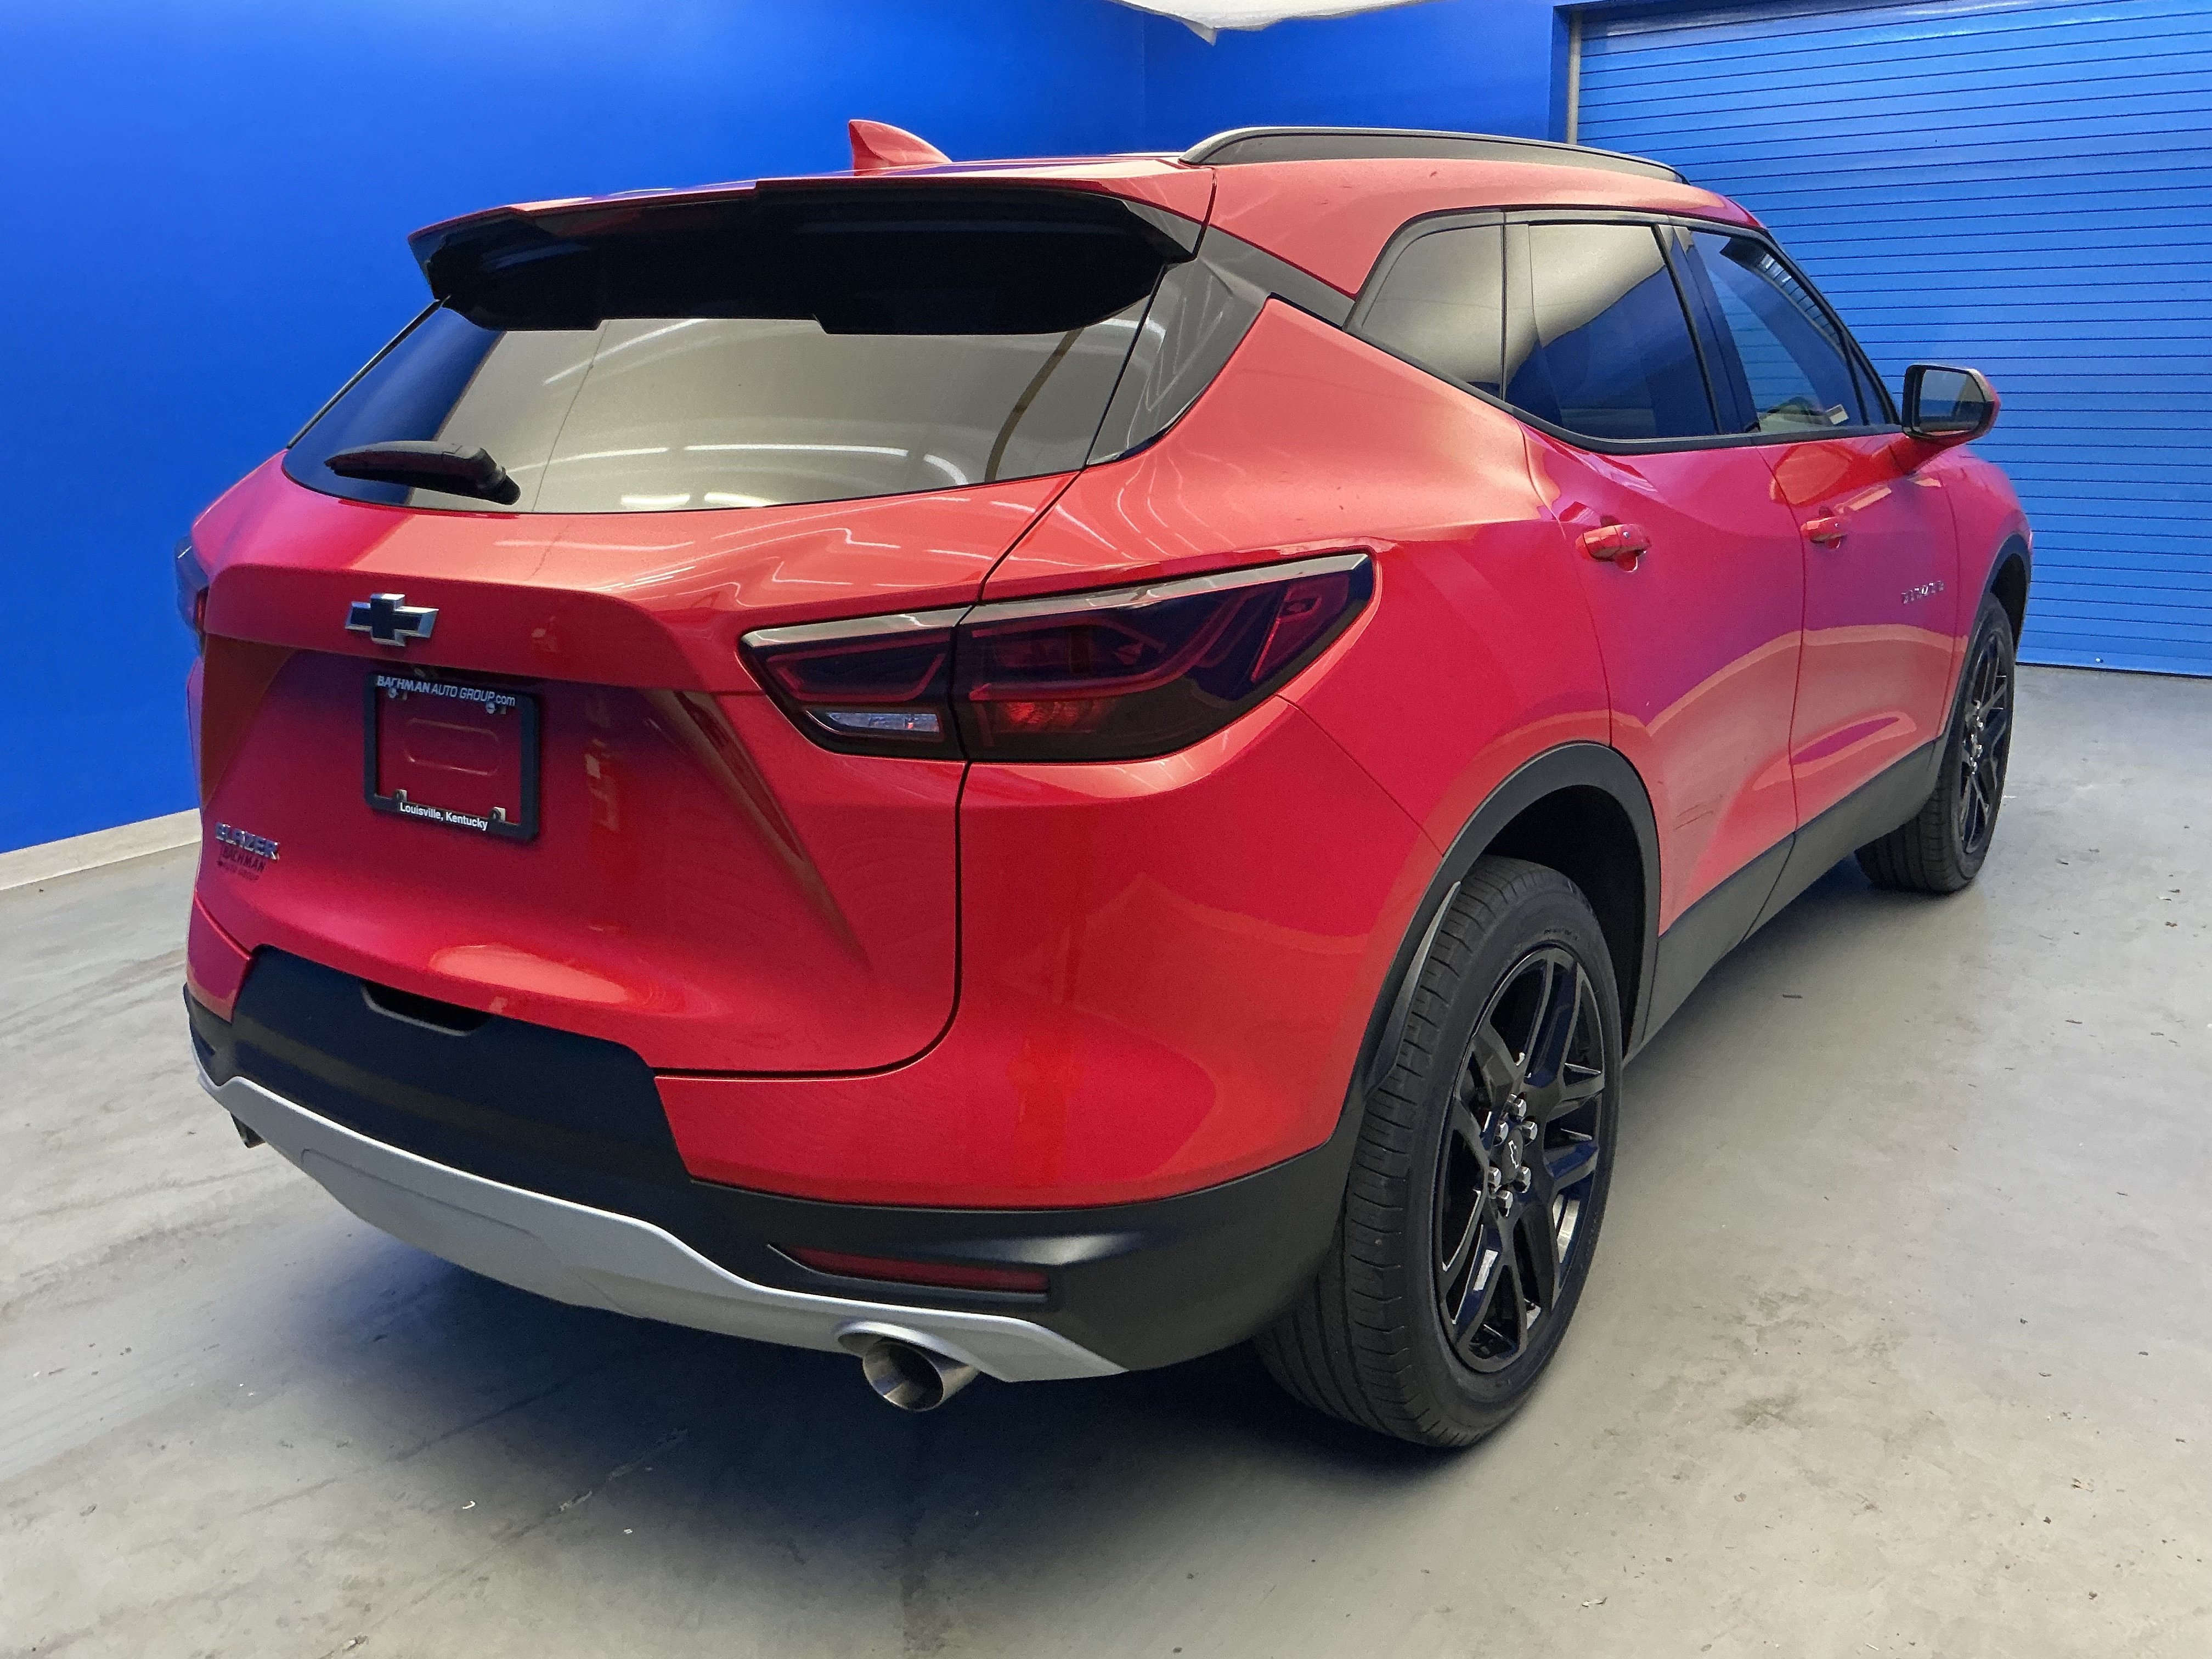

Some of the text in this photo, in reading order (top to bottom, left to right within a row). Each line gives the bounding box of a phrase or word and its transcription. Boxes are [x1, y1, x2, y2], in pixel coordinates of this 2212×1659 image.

[432, 684, 458, 697] AUTO
[400, 802, 488, 831] Louisville, Kentucky
